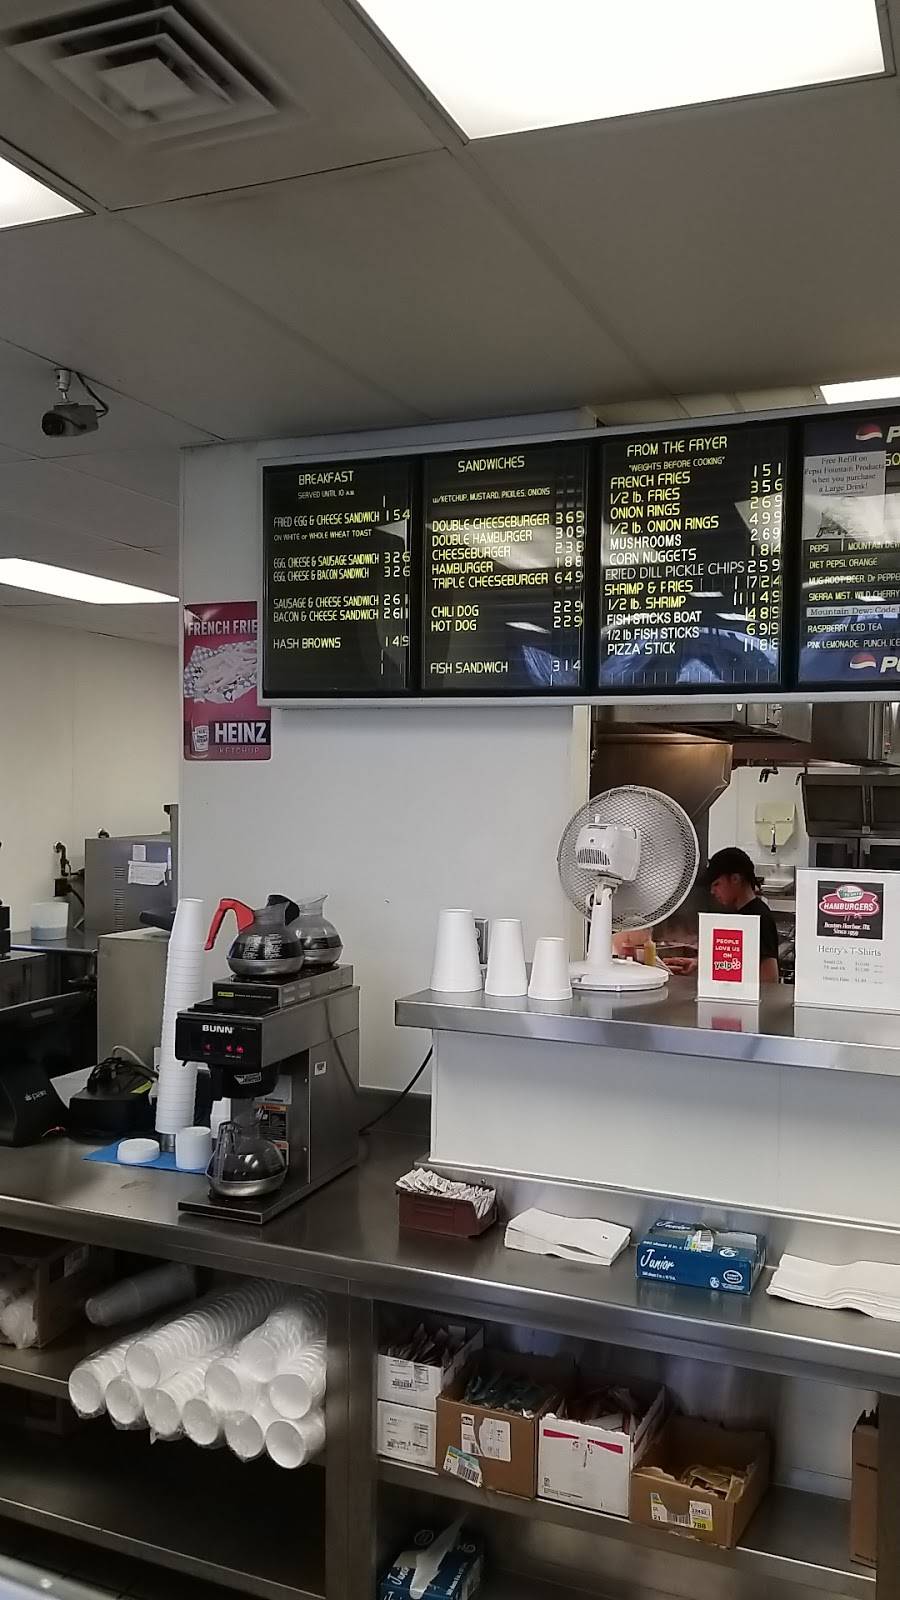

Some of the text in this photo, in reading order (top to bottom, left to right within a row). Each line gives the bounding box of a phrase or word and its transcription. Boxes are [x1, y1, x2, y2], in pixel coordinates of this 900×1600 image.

[626, 435, 728, 457] FROM THE FRYER
[457, 455, 525, 473] SANDWICHES
[663, 459, 691, 471] BEFORE
[298, 470, 354, 485] BREAKFAST
[610, 475, 654, 490] FRENCH
[657, 471, 691, 486] FRIES
[298, 491, 320, 499] SERVED
[321, 489, 337, 497] UNTIL
[527, 487, 551, 497] ONIONS
[610, 491, 629, 505] 1/2
[647, 487, 681, 502] FRIES
[610, 506, 644, 520] ONION
[647, 503, 681, 518] RINGS
[273, 516, 292, 528] FRIED
[293, 515, 308, 527] EGG
[309, 514, 314, 525] &
[317, 513, 342, 526] CHEESE
[344, 511, 380, 524] SANDWICH
[432, 519, 470, 533] DOUBLE
[472, 513, 550, 530] CHEESEBURGER
[609, 522, 628, 536] 1/2
[647, 518, 682, 533] ONION
[684, 515, 720, 530] RINGS
[273, 534, 282, 542] ON
[283, 532, 300, 541] WHITE
[309, 531, 328, 540] WHOLE
[329, 530, 350, 538] WHEAT
[352, 529, 372, 537] TOAST
[432, 533, 470, 547] DOUBLE
[472, 529, 533, 545] HAMBURGER
[610, 534, 682, 550] MUSHROOMS
[432, 546, 511, 561] CHEESEBURGER
[809, 543, 829, 553] PEPSI
[287, 556, 310, 568] CHEESE
[311, 556, 317, 567] &
[317, 554, 347, 567] SAUSAGE
[348, 553, 380, 566] SANDWICH
[609, 548, 697, 566] CORN NUGGETS
[809, 558, 878, 570] DIET ORANGE
[287, 570, 310, 582] CHEESE
[311, 570, 316, 581] &
[317, 569, 338, 581] BACON
[339, 567, 370, 580] SANDWICH
[431, 561, 494, 575] HAMBURGER
[605, 567, 637, 581] FRIED
[640, 566, 662, 579] DILL
[665, 563, 704, 578] PICKLE
[708, 561, 745, 575] CHIPS
[432, 576, 465, 589] TRIPLE
[468, 572, 549, 588] CHEESEBURGER
[808, 577, 824, 585] MUG
[824, 575, 844, 584] ROOT
[604, 579, 694, 597] SHRIMP & FRIES
[273, 597, 307, 609] SAUSAGE
[308, 597, 314, 608] &
[315, 596, 342, 608] CHEESE
[343, 595, 379, 608] SANDWICH
[608, 598, 627, 611] 1/2
[645, 595, 687, 610] SHRIMP
[808, 592, 833, 602] SIERRA
[855, 591, 872, 599] WILD
[273, 608, 379, 623] BACON & CHEESE SANDWICH
[431, 605, 454, 618] CHILI
[457, 604, 479, 617] DOG
[607, 610, 702, 626] FISH STICKS BOAT
[810, 608, 850, 616] Mountain
[188, 619, 257, 636] FRENCH FRIE
[431, 620, 452, 632] HOT
[455, 619, 477, 632] DOG
[807, 622, 883, 633] RASPBERRY ICED TEA
[607, 626, 700, 642] 1/2 lb FISH STICKS
[273, 638, 299, 649] HASH
[301, 637, 342, 649] BROWNS
[607, 641, 676, 656] PIZZA STICK
[807, 641, 820, 649] PINK
[430, 662, 452, 674] FISH
[455, 661, 508, 674] SANDWICH
[214, 722, 267, 744] HEINZ
[823, 902, 874, 911] HAMBURGERS
[818, 945, 882, 956] Henry's T-Shirts
[714, 961, 732, 971] yelp
[202, 1025, 233, 1034] BUNN
[656, 1221, 691, 1230] Junior
[640, 1249, 675, 1270] Junior
